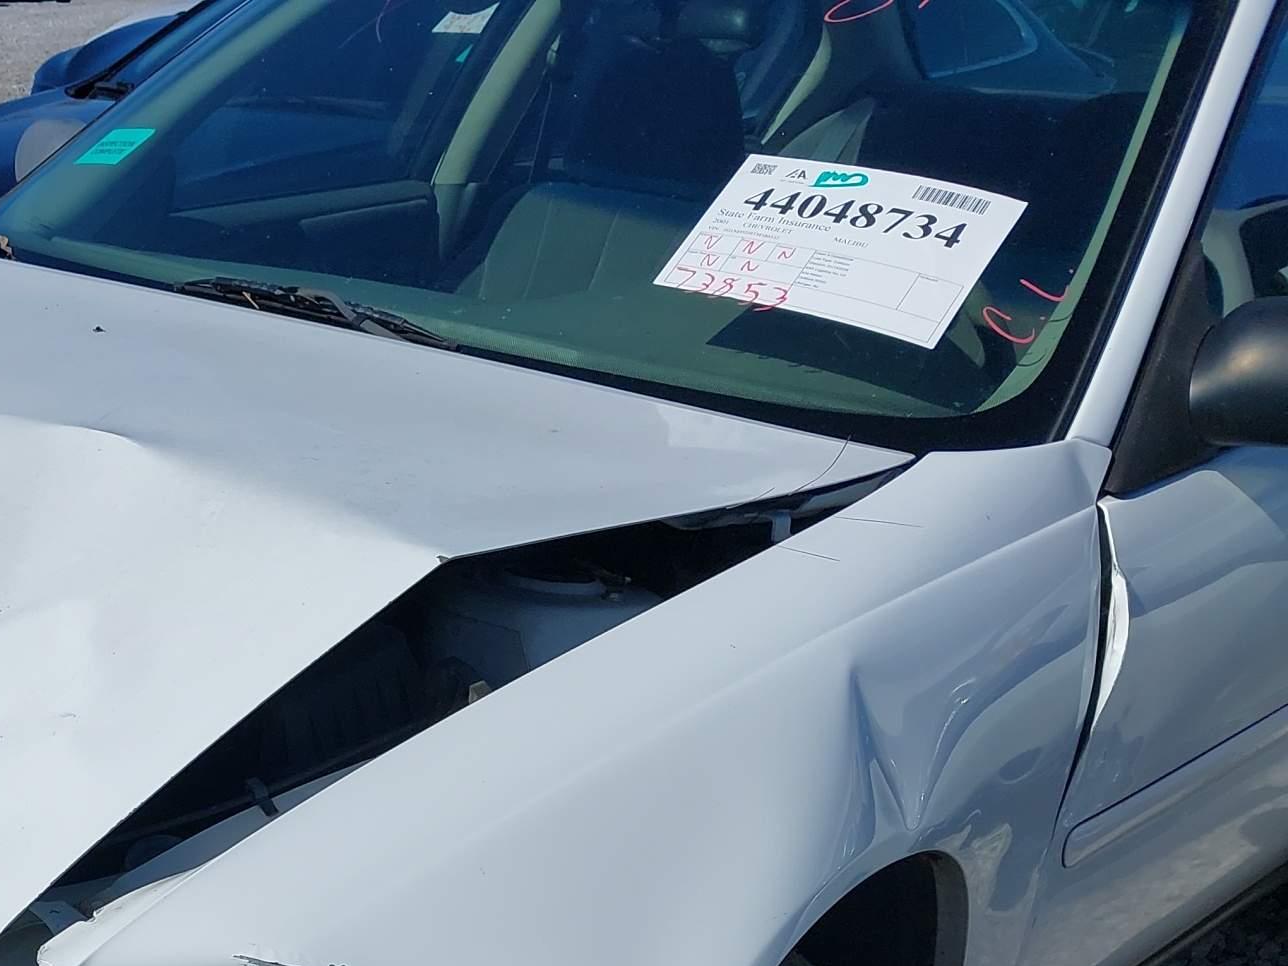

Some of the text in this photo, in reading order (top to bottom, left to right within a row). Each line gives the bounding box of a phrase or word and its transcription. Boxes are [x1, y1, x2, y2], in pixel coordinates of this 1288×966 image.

[720, 208, 832, 232] State Farm Insurance
[743, 187, 968, 249] 44048734
[743, 222, 793, 235] CHEVROLET
[833, 237, 869, 248] MALIBU
